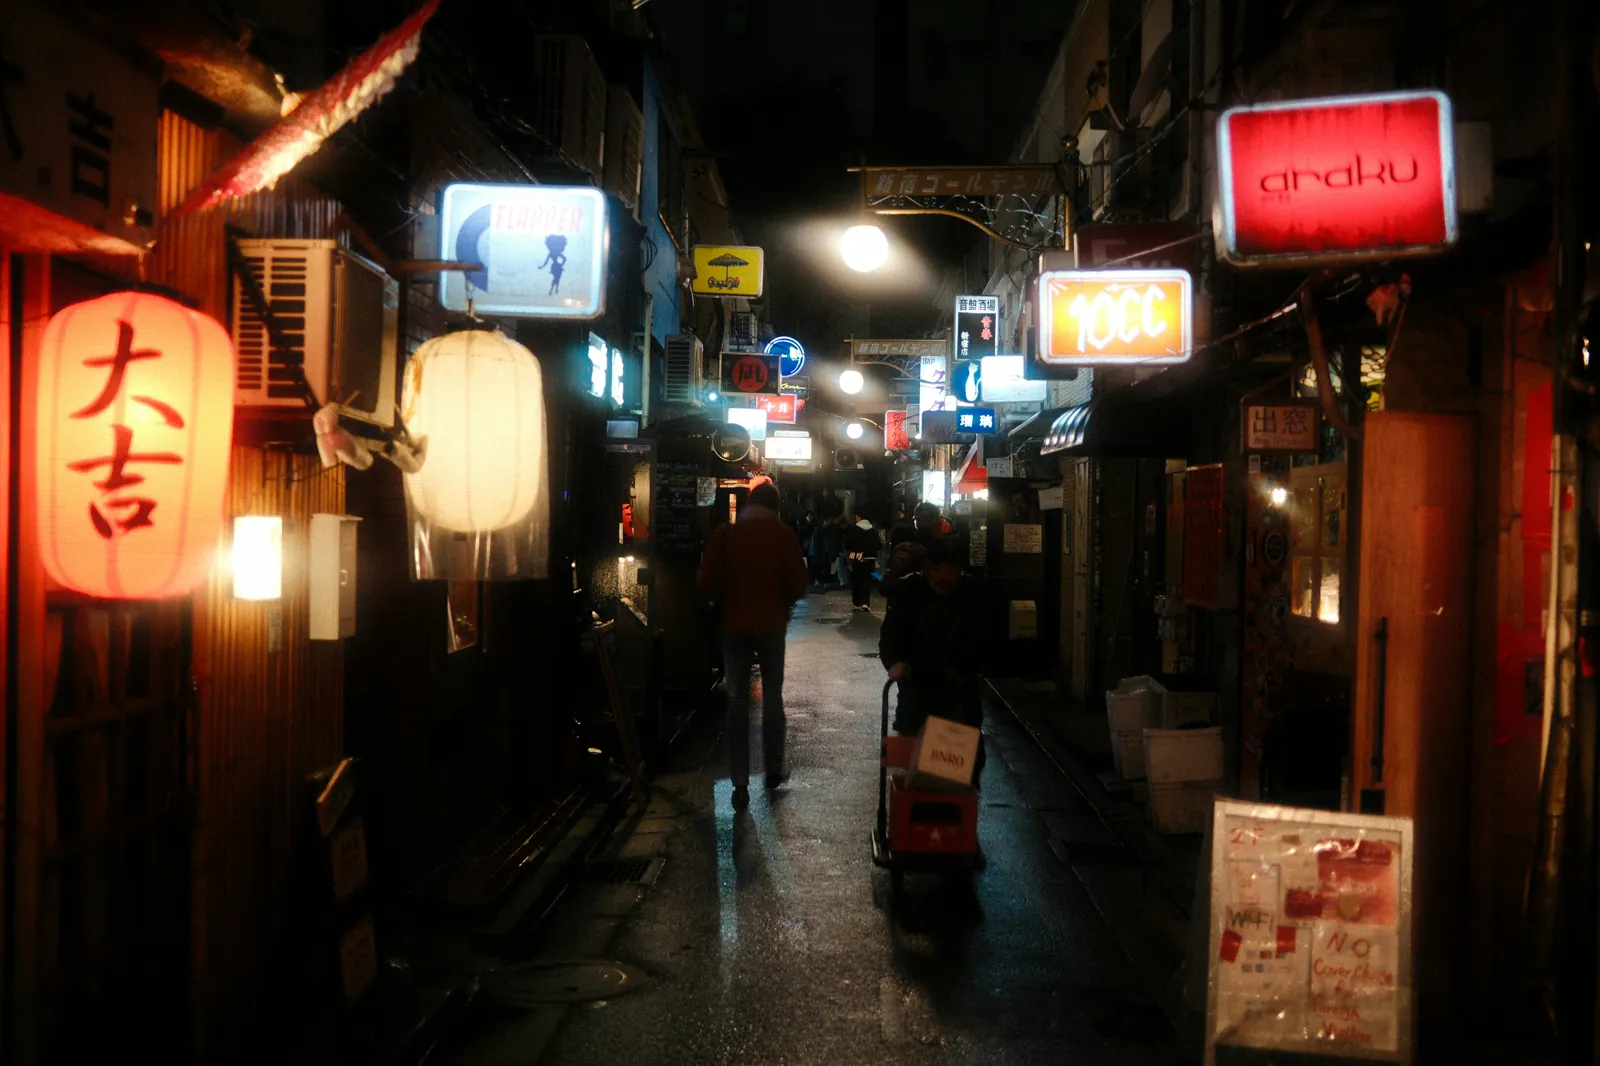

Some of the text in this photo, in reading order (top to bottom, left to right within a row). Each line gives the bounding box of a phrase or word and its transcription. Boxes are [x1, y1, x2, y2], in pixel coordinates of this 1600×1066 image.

[874, 172, 1057, 195] 新宿ゴールデン街
[1259, 153, 1419, 194] araku
[495, 204, 584, 233] FLAPPER
[959, 298, 997, 312] 音盤酒場
[67, 317, 186, 541] 大吉
[930, 749, 965, 768] JINRO
